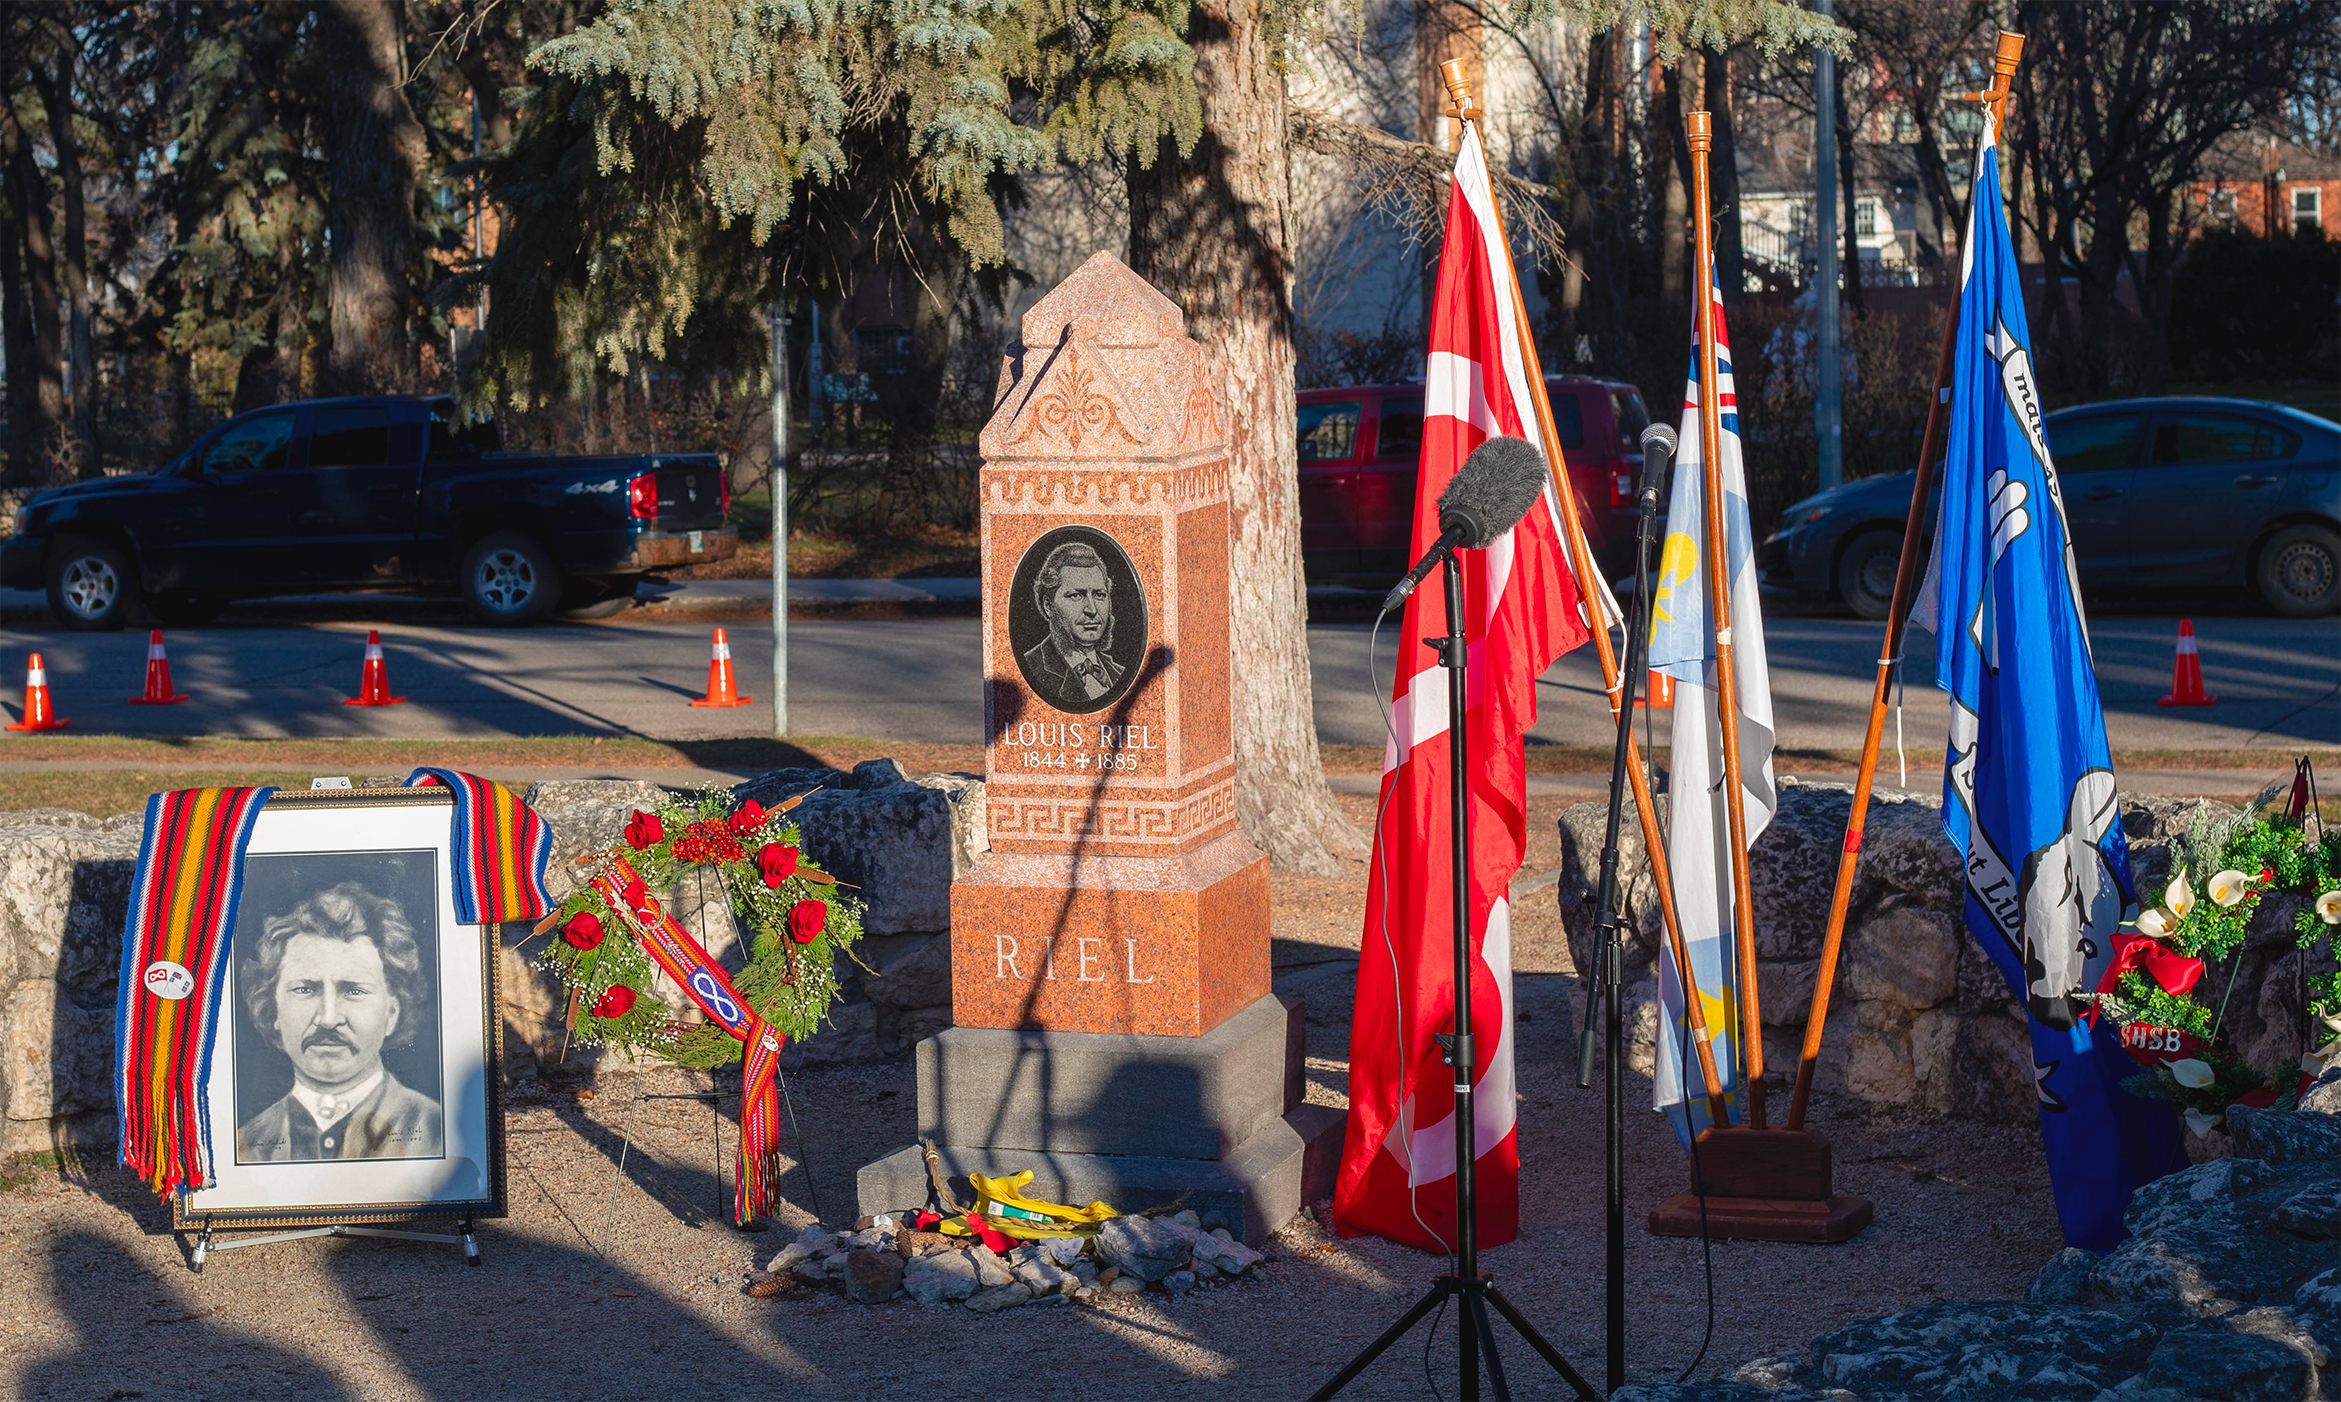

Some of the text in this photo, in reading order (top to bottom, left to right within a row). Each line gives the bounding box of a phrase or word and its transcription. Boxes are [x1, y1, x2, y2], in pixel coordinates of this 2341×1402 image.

[1004, 722, 1158, 749] LOUIS RIEL
[1023, 751, 1138, 770] 1844 1885
[994, 934, 1154, 983] RIEL
[2121, 1025, 2181, 1052] SHSB
